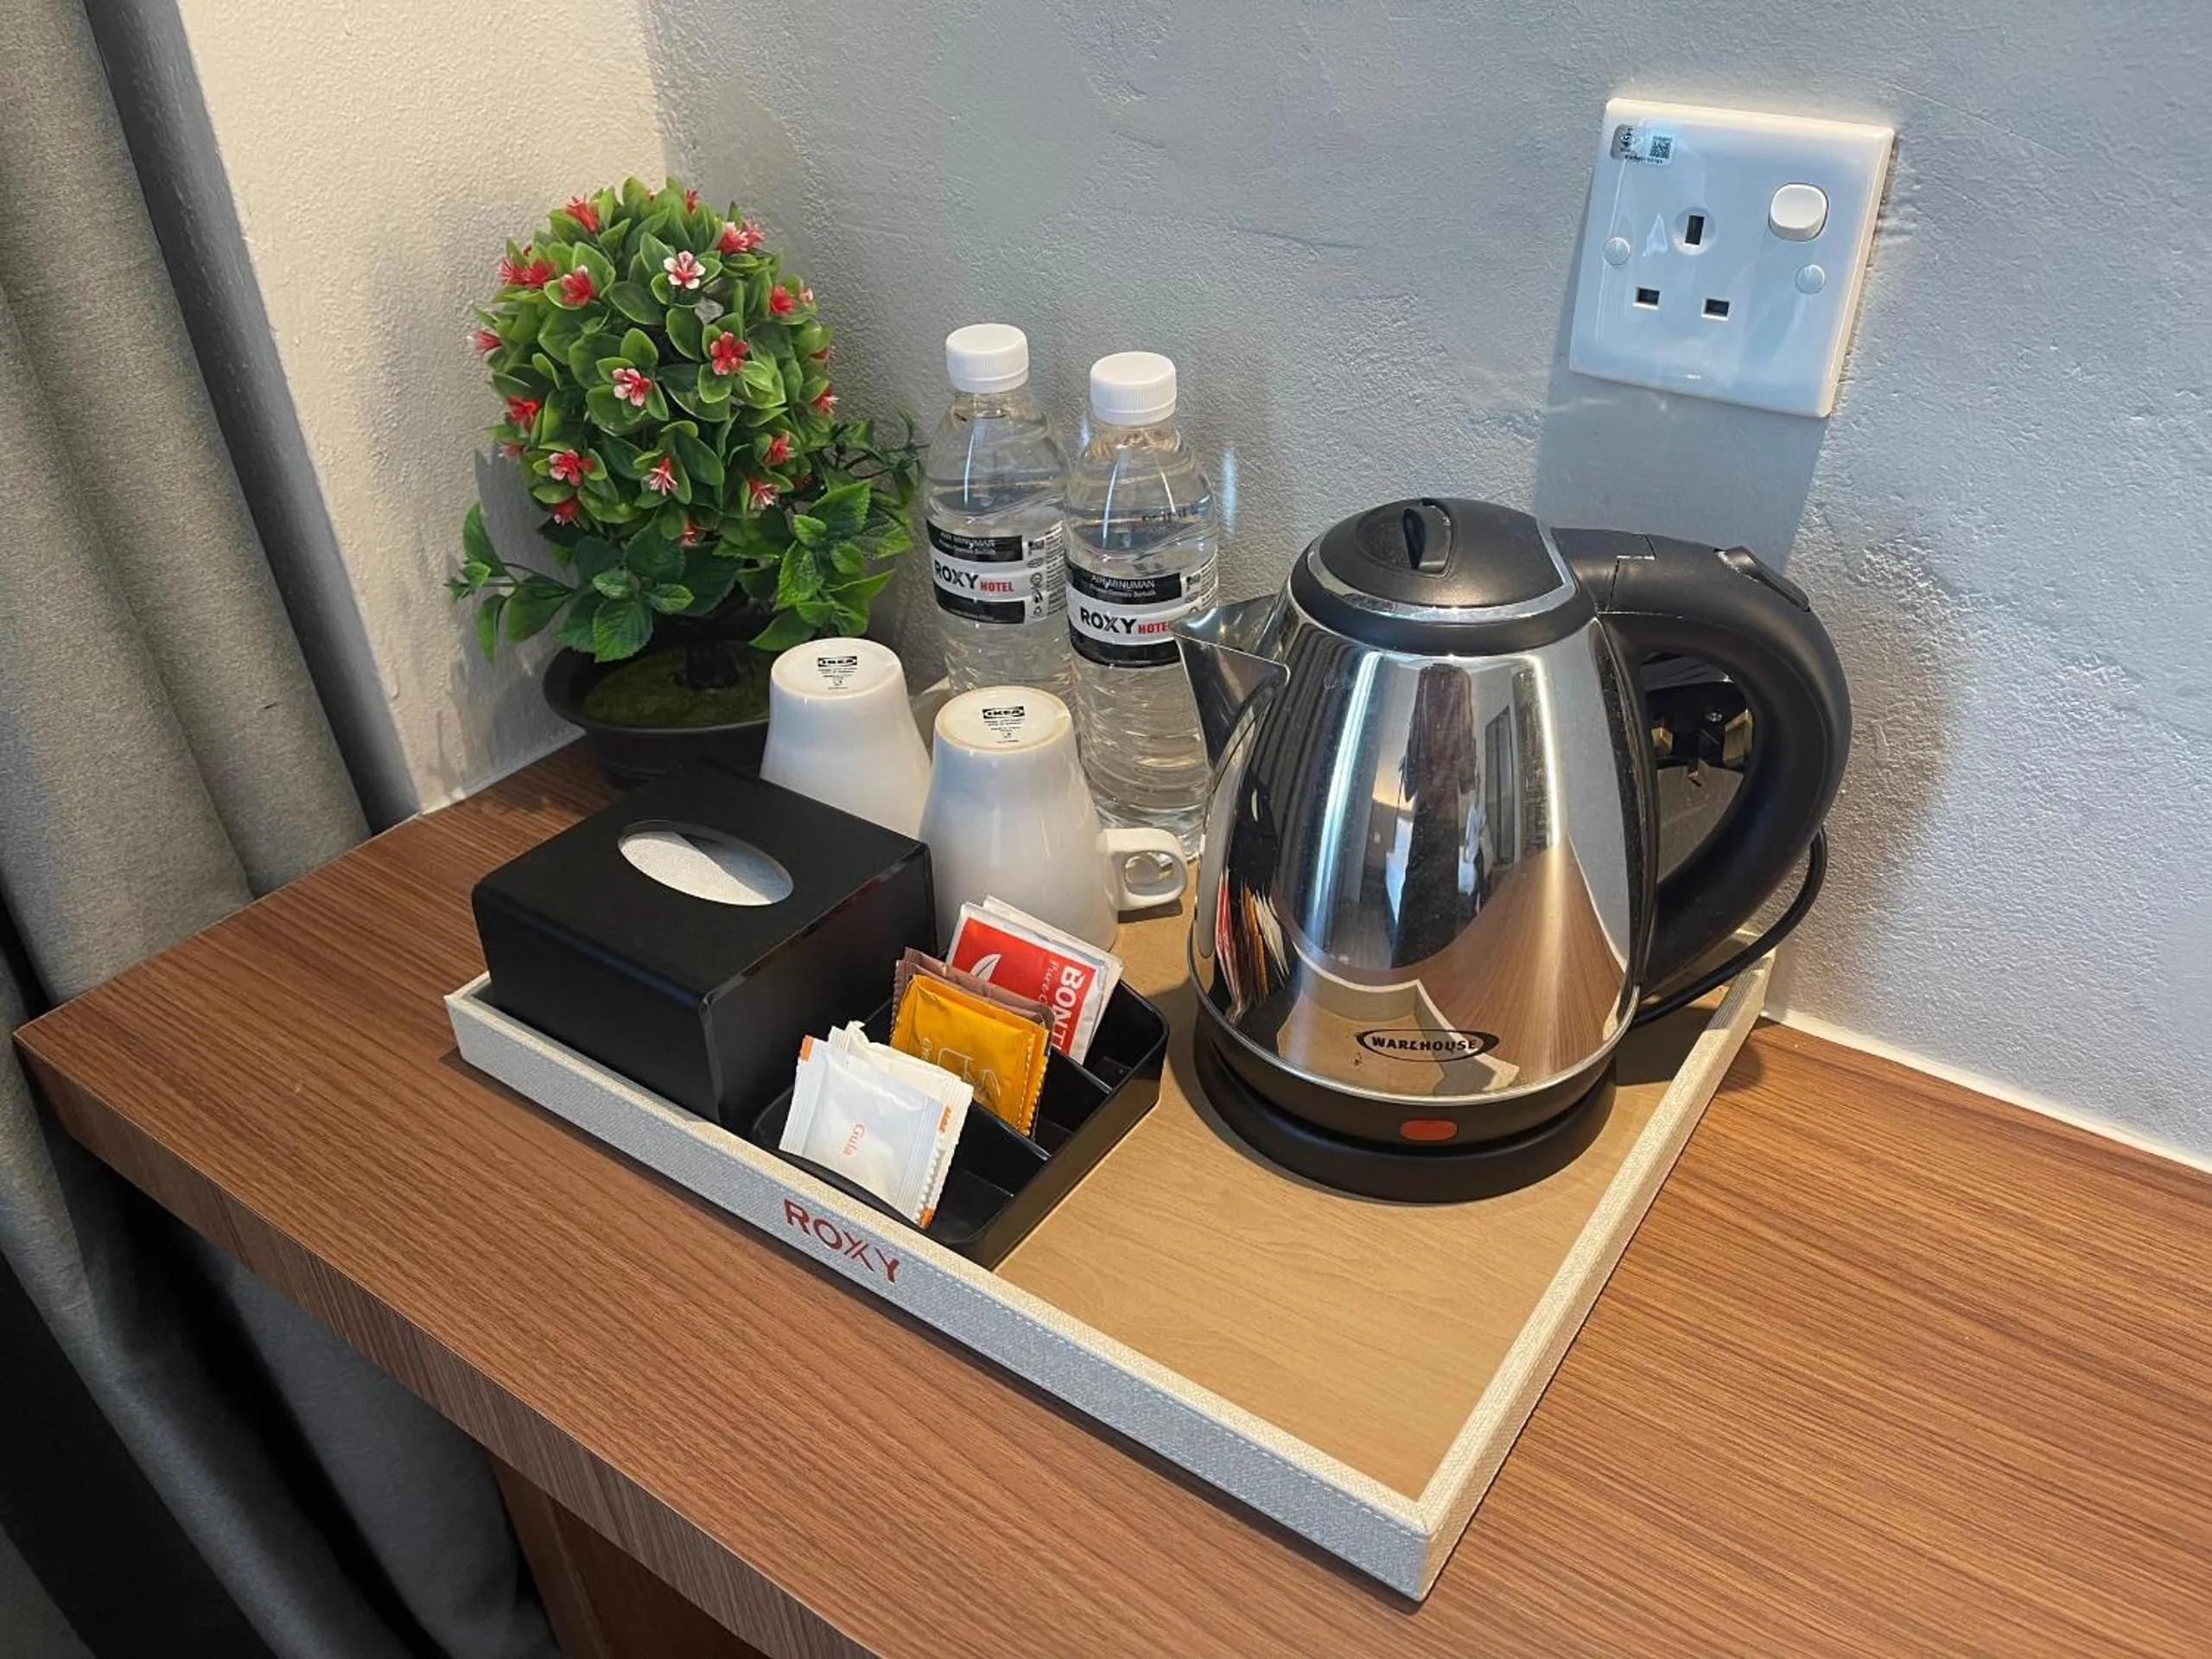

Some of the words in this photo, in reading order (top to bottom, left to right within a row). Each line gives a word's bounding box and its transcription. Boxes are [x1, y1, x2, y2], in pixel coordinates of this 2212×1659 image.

[935, 560, 978, 589] ROXY
[980, 581, 1014, 592] HOTEL
[1080, 607, 1137, 634] ROXY
[1137, 621, 1170, 634] HOTE
[818, 657, 857, 666] IKEA
[982, 707, 1024, 718] IKEA
[1371, 1036, 1478, 1054] WAREHOUSE
[784, 1198, 899, 1284] ROXY
